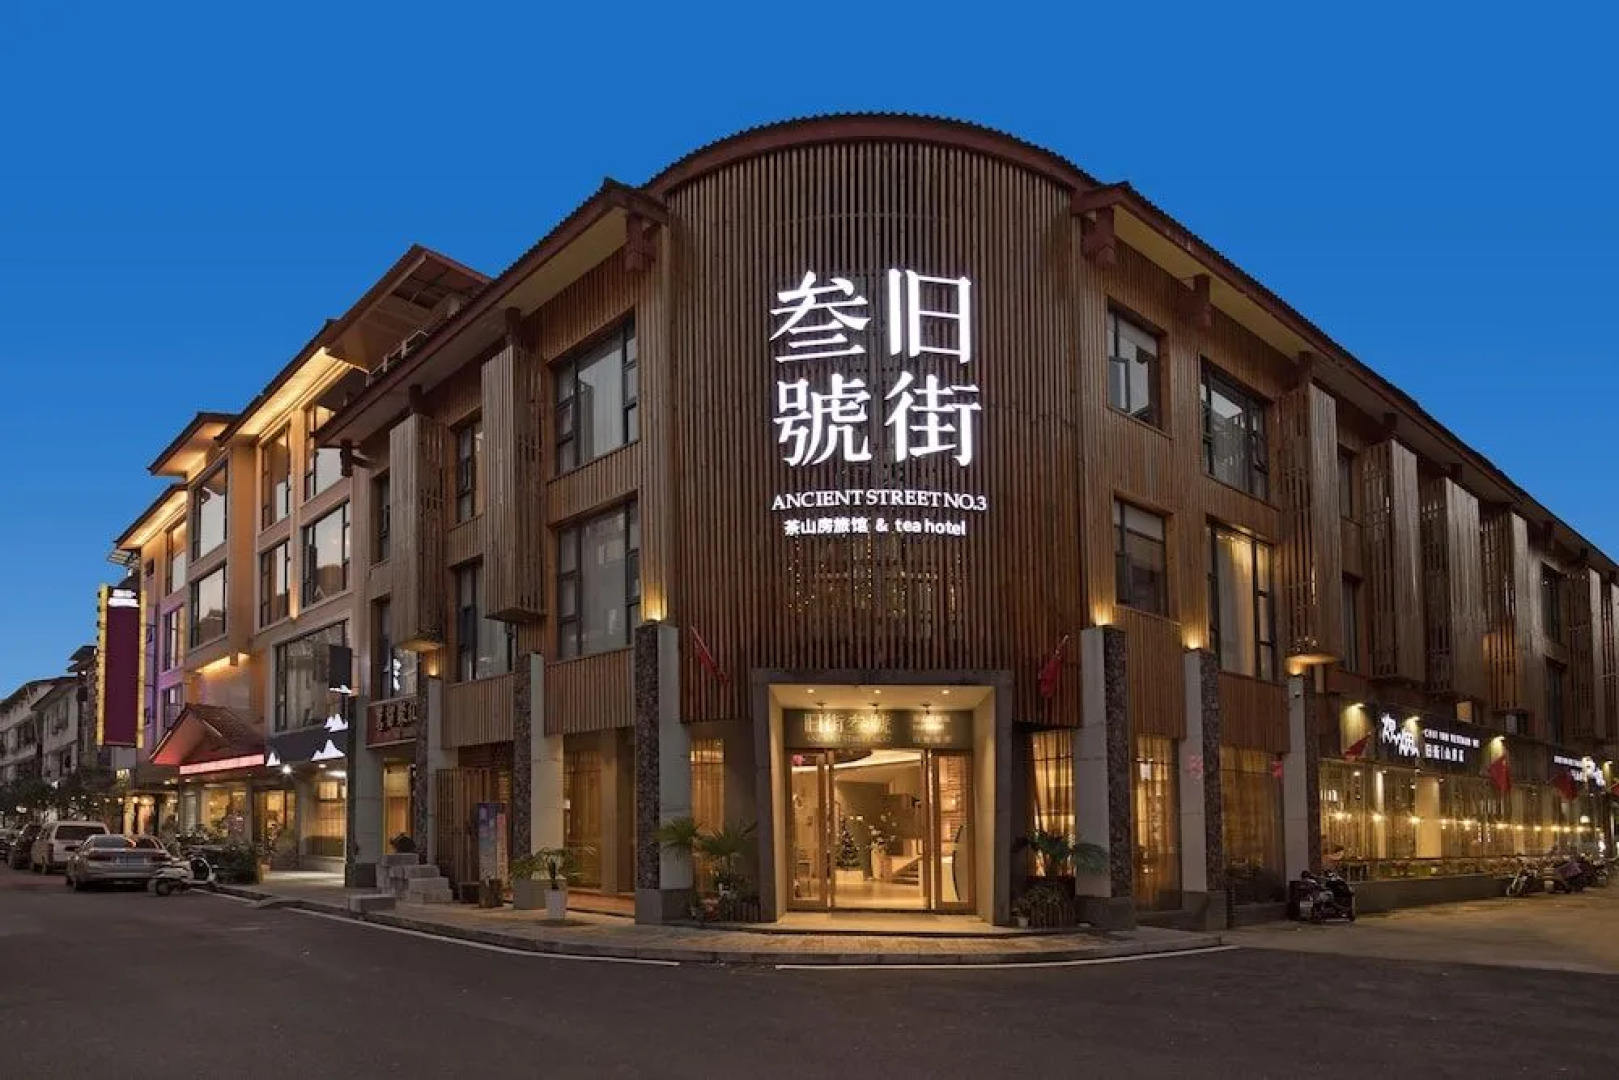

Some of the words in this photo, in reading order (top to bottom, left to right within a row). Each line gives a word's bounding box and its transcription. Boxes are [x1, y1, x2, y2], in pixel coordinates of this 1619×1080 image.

[769, 270, 872, 466] 叁號
[885, 268, 981, 466] 旧街
[772, 489, 863, 510] ANCIENT
[866, 489, 942, 507] STREET
[944, 492, 986, 510] NO.3
[876, 518, 889, 532] &
[892, 518, 921, 533] tea
[924, 518, 966, 536] hotel
